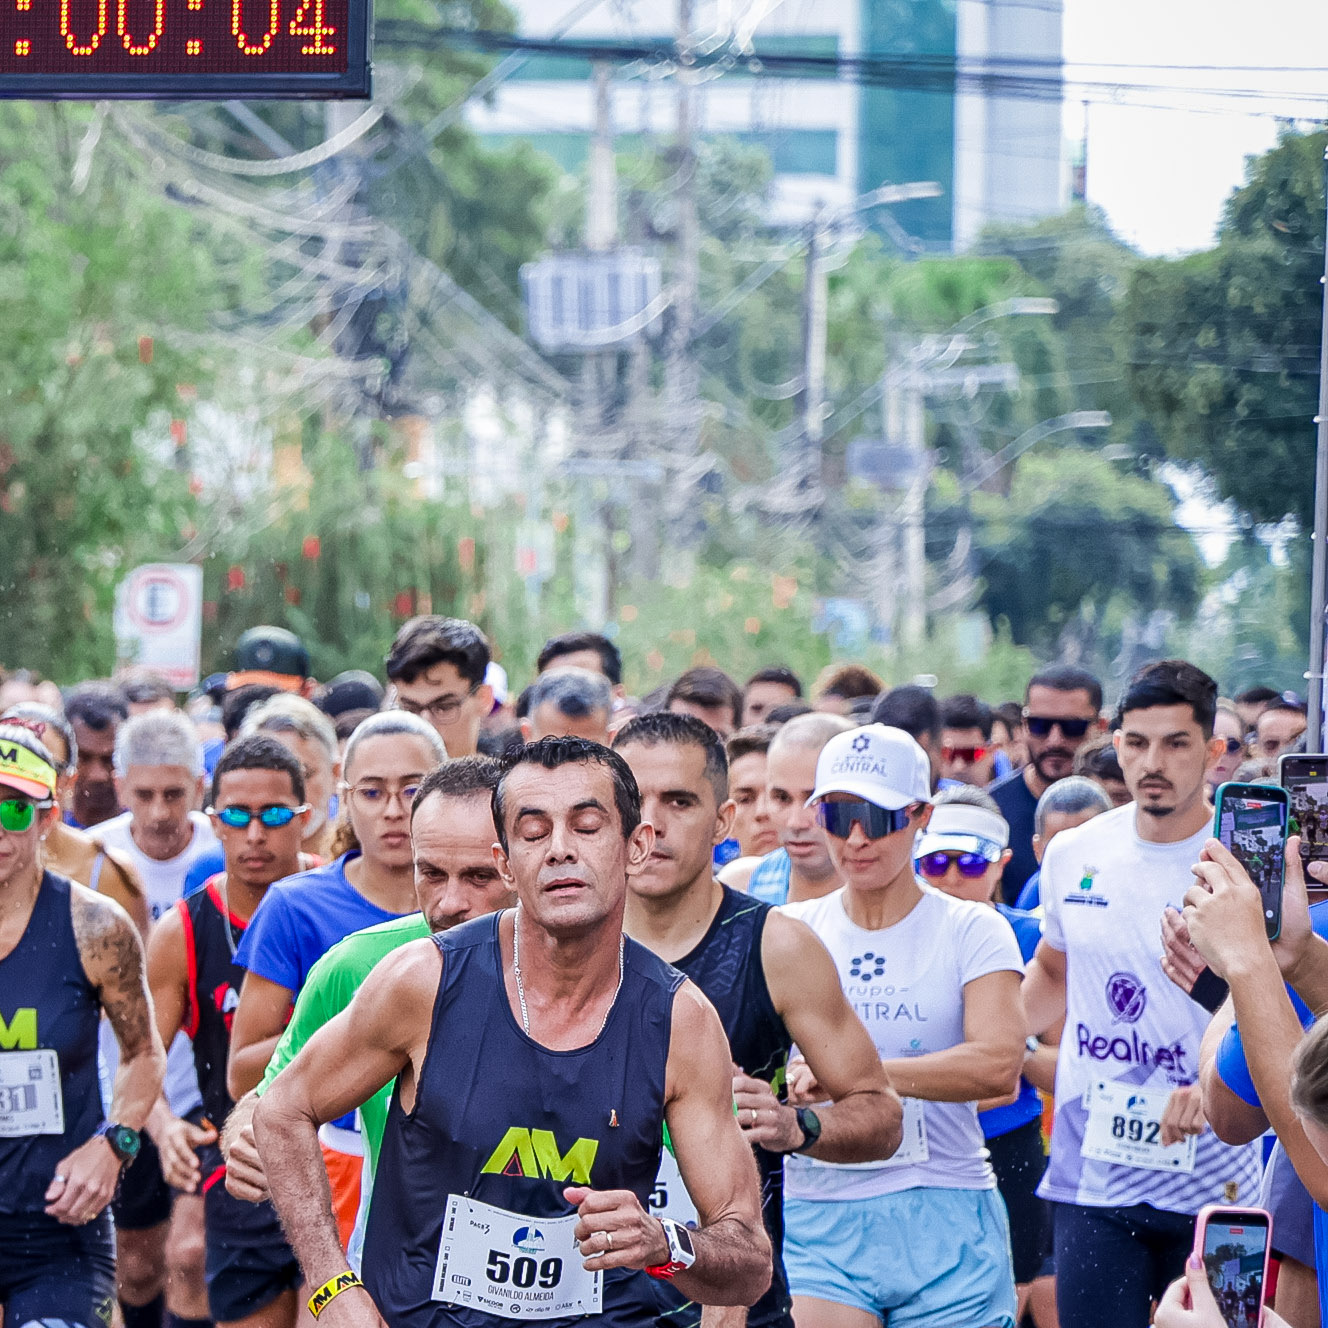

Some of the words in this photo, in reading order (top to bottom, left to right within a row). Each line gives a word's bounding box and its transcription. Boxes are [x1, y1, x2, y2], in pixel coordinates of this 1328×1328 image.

[844, 985, 895, 997] rupo
[855, 1002, 928, 1021] TRAL
[486, 1249, 563, 1289] 509
[488, 1285, 523, 1300] GIVANILDO
[524, 1292, 554, 1301] ALMEIDA
